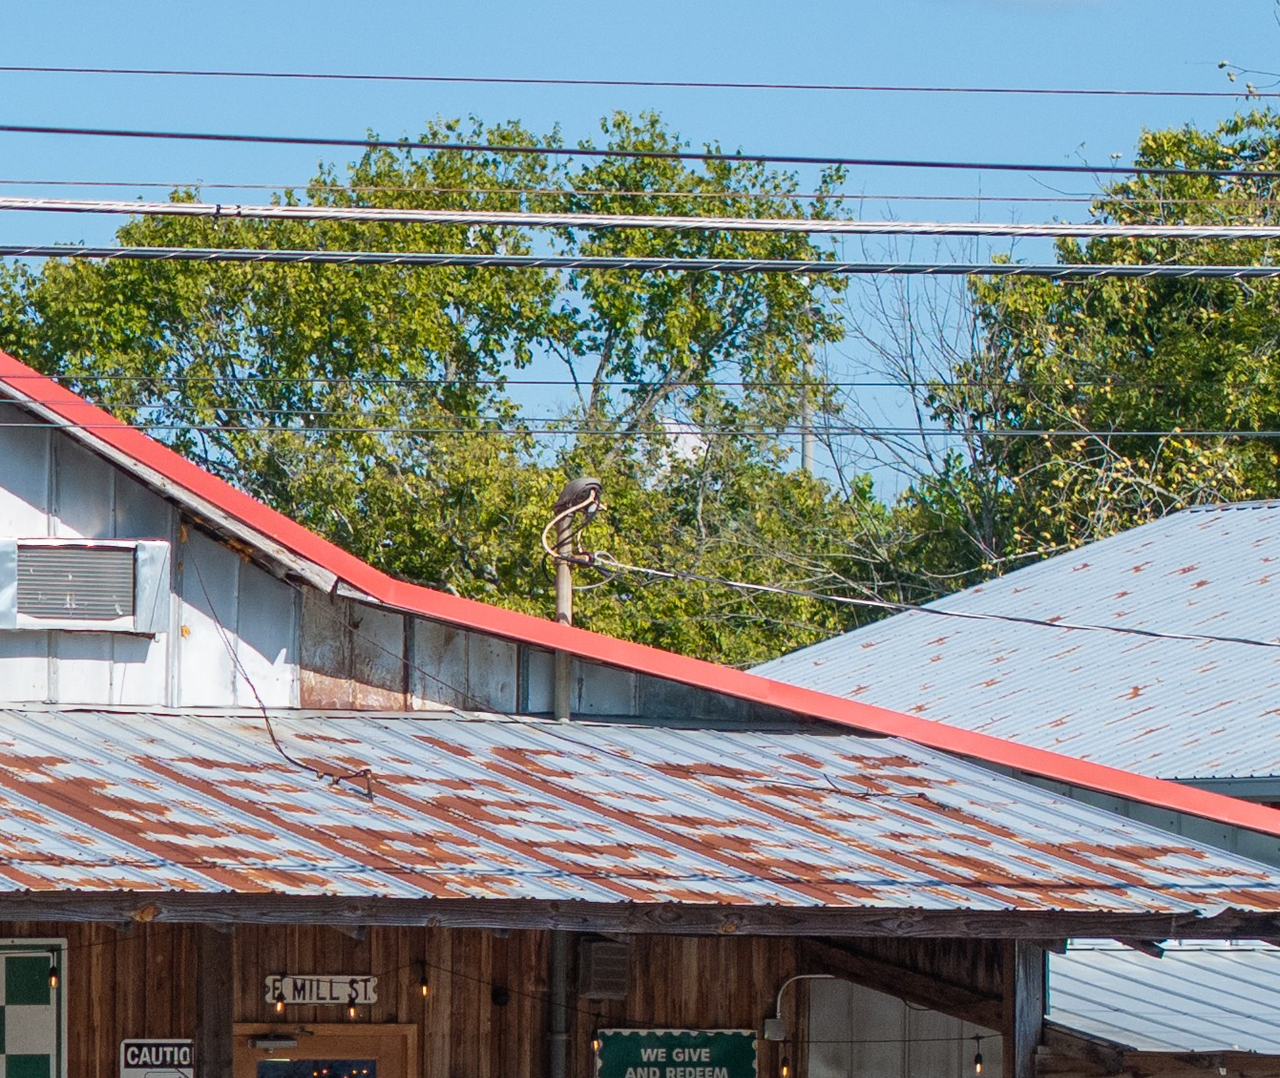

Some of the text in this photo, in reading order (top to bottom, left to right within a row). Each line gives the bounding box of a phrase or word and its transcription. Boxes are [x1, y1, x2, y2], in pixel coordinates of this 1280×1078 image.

[292, 979, 340, 1001] MILL
[126, 1046, 194, 1066] CAUTIO
[640, 1048, 711, 1062] WE GIVE
